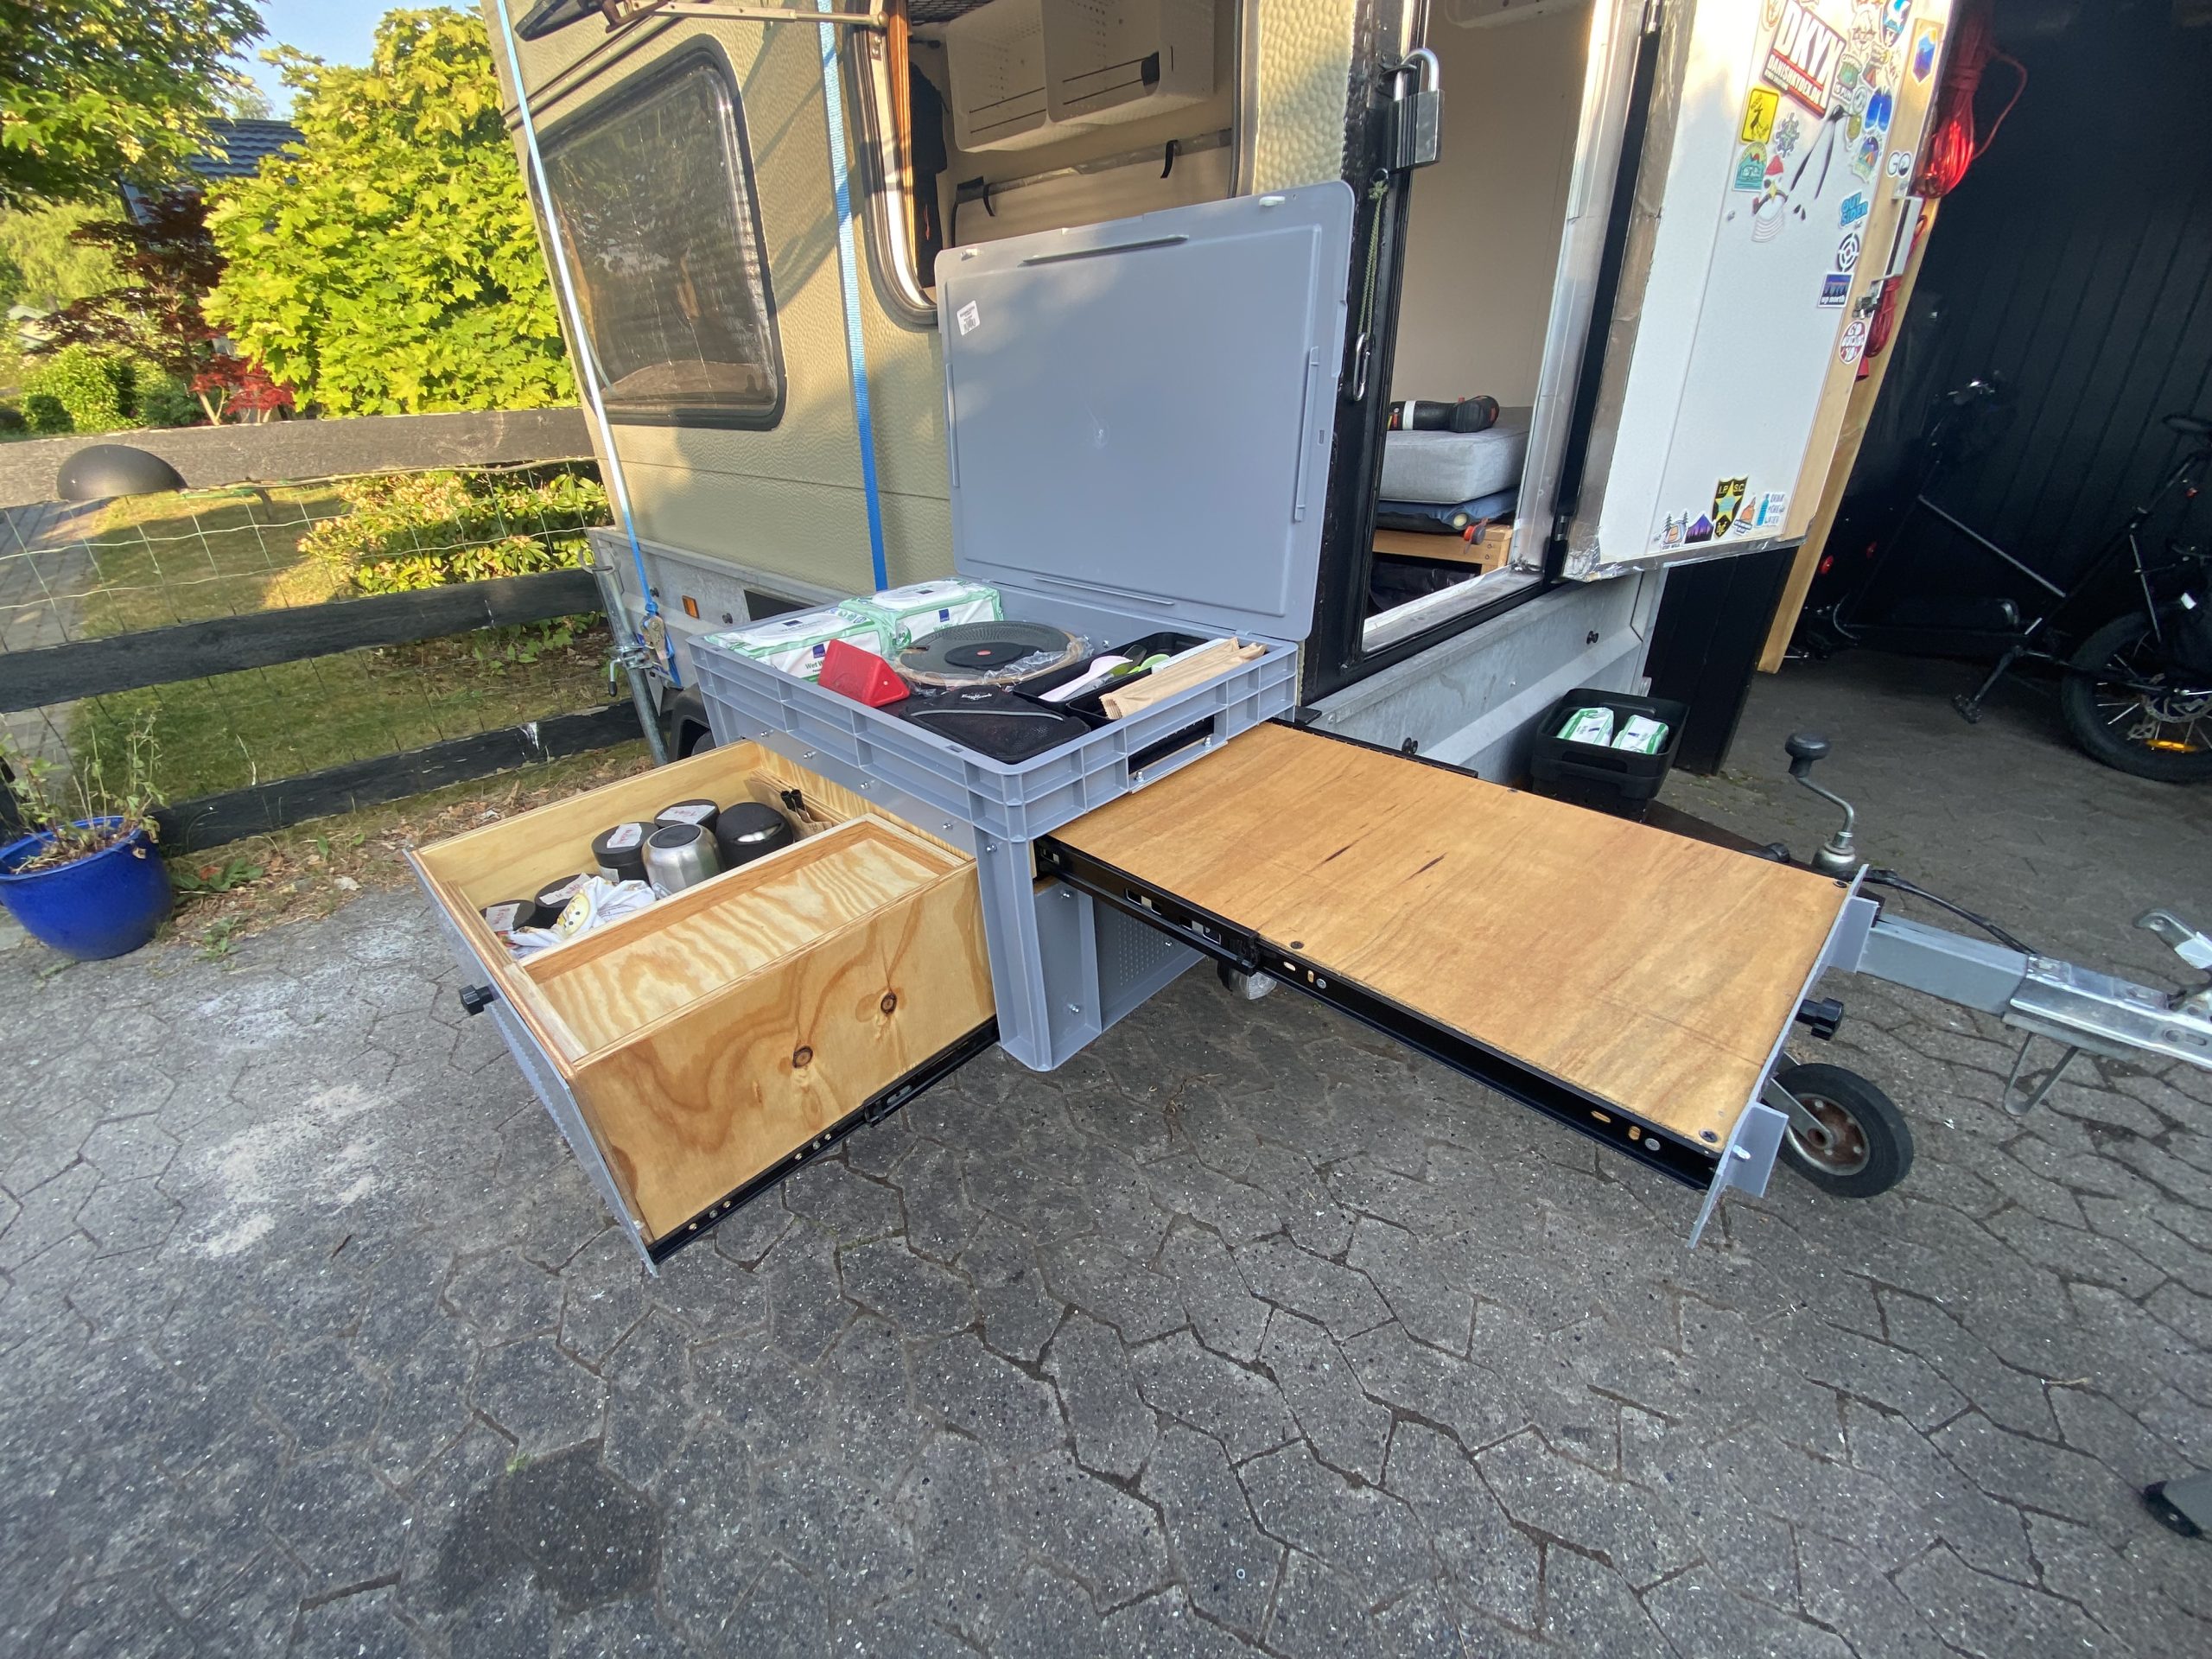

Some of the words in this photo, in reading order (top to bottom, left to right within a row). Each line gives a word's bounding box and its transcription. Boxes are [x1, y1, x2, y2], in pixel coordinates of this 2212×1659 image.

[1773, 0, 1846, 111] DKYX
[1767, 54, 1822, 105] DANISHKYDEX.DK
[1887, 152, 1911, 176] GO
[1840, 200, 1868, 226] SIDER
[1841, 192, 1861, 213] OUT
[1829, 294, 1846, 303] north
[805, 659, 818, 670] Wet
